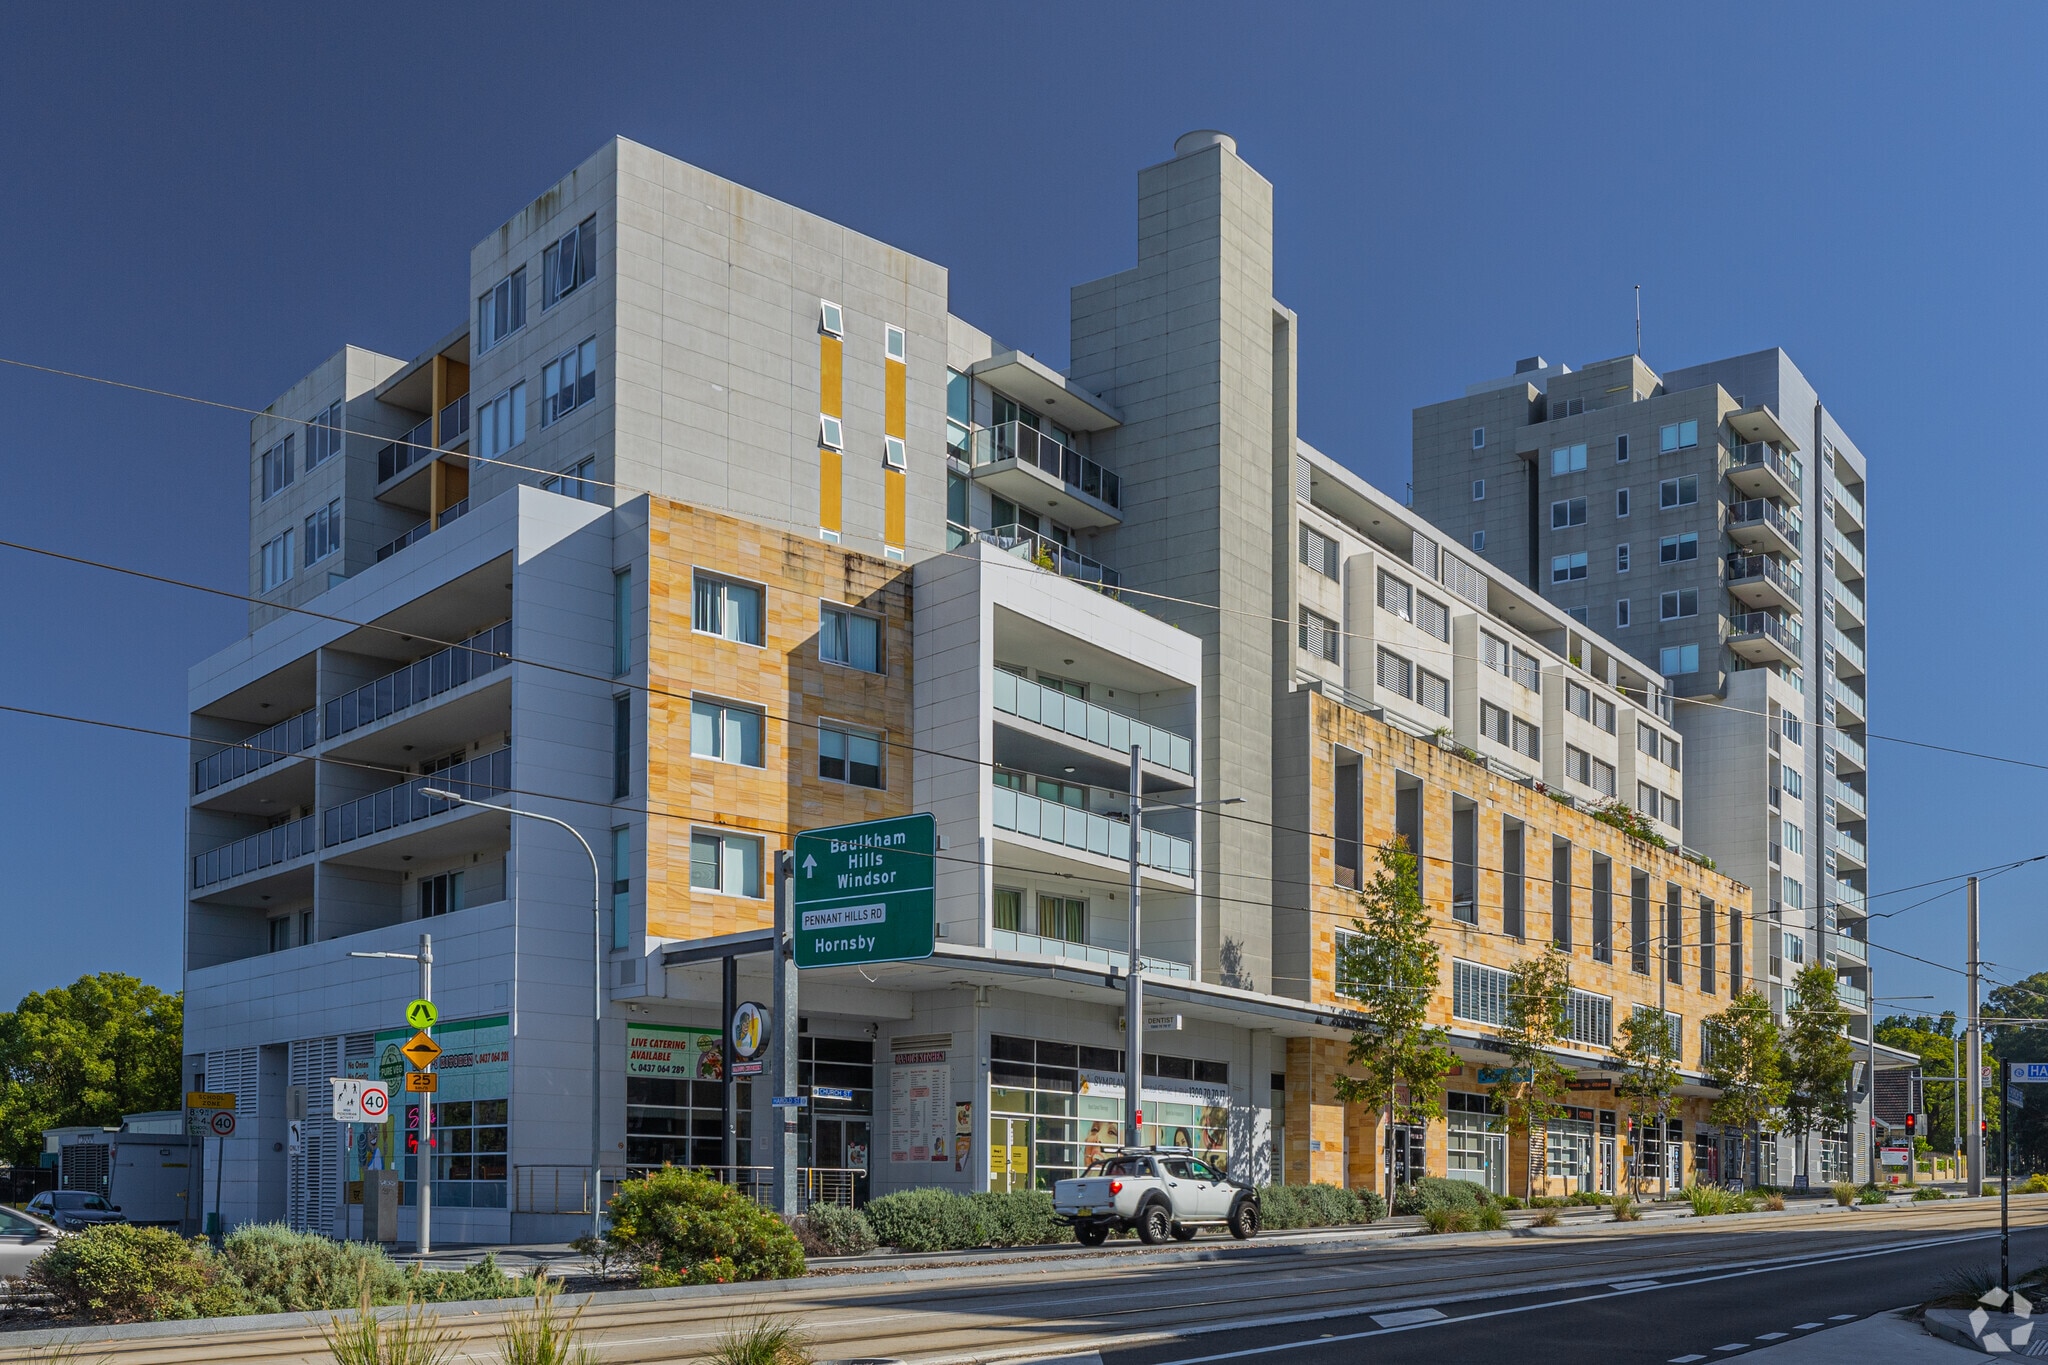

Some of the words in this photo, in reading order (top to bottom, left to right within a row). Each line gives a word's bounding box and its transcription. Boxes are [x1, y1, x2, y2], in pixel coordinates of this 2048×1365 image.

[830, 832, 906, 853] Baulkham
[848, 852, 883, 869] Hills
[837, 871, 897, 889] Windsor
[804, 912, 842, 926] PENNANT
[844, 909, 868, 922] HILLS
[870, 908, 882, 919] RD
[815, 935, 876, 953] Hornsby
[1147, 1016, 1174, 1025] DENTIST
[630, 1037, 648, 1048] LIVE
[649, 1038, 686, 1050] CATERING
[630, 1050, 672, 1061] AVAILABLE
[638, 1064, 655, 1072] 0437
[657, 1064, 670, 1073] 064
[671, 1065, 685, 1074] 289
[413, 1074, 431, 1085] 25
[819, 1088, 842, 1096] CHURCH
[1188, 1086, 1202, 1098] 1300
[1203, 1087, 1211, 1100] 70
[1211, 1088, 1219, 1101] 70
[365, 1096, 384, 1108] 40
[215, 1118, 232, 1128] 40
[289, 1144, 300, 1152] ONLY
